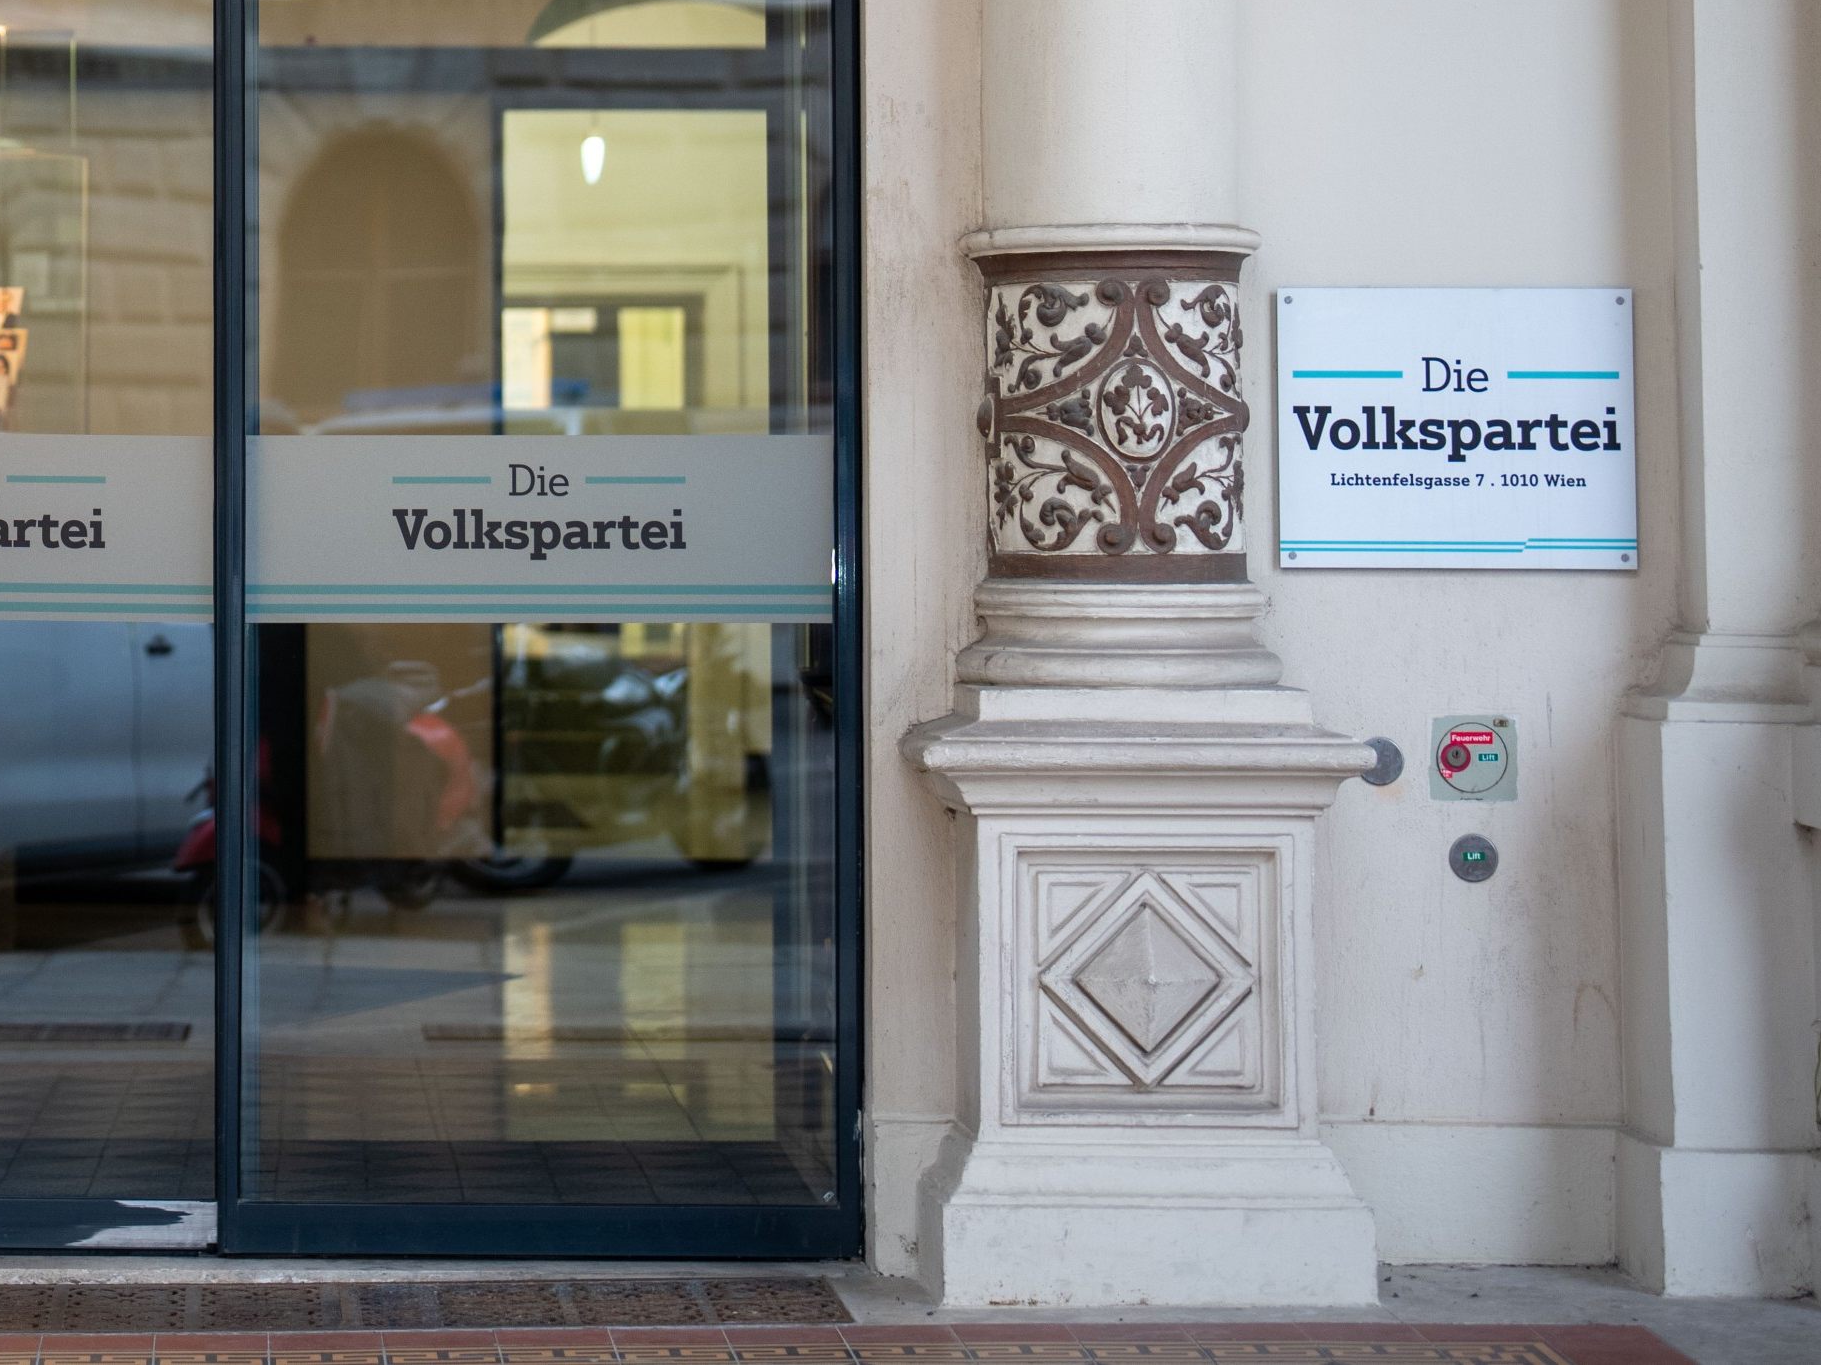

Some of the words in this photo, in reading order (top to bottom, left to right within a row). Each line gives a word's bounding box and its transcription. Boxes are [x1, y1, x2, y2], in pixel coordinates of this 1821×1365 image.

[1421, 356, 1489, 393] Die
[1292, 405, 1622, 463] Volkspartei
[508, 463, 570, 497] Die
[1330, 472, 1471, 490] Lichtenfelsgasse
[1475, 473, 1485, 487] 7
[1500, 473, 1539, 487] 1010
[1543, 473, 1587, 488] Wien
[392, 508, 687, 561] Volkspartei
[1451, 734, 1491, 742] Feuerwehr
[1481, 753, 1496, 761] Lift
[1467, 852, 1481, 860] Lift
